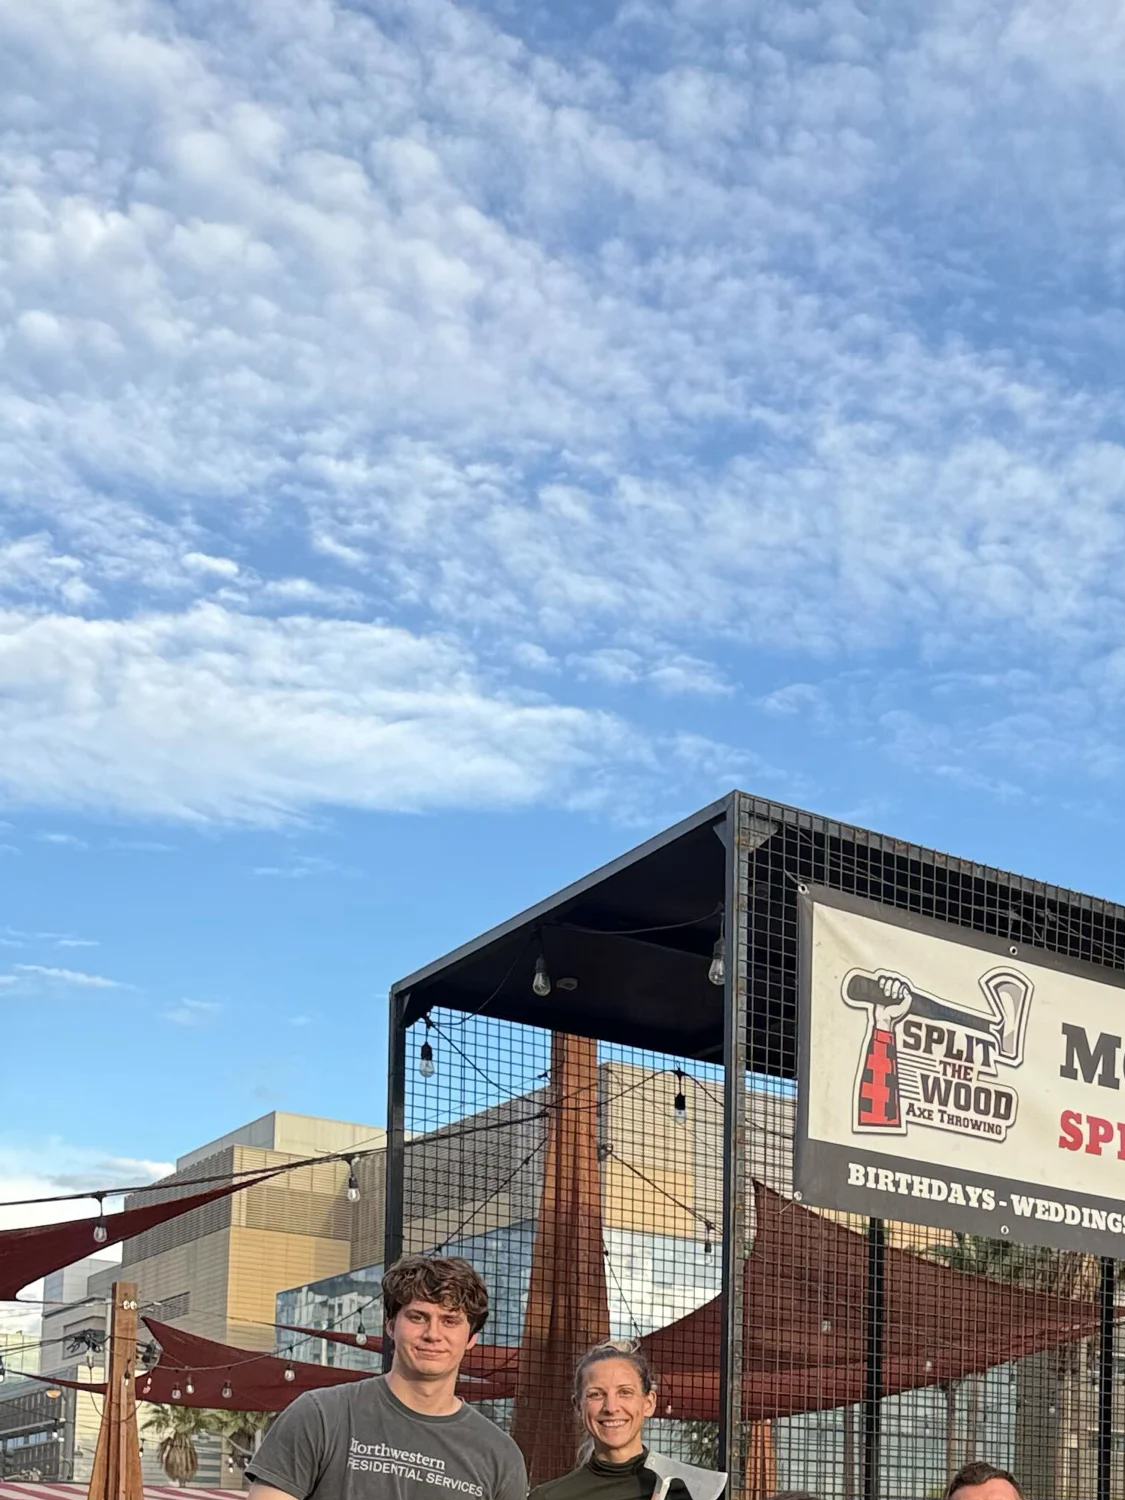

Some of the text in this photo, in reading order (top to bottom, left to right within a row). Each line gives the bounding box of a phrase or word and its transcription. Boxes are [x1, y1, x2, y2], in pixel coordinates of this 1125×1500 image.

[903, 1020, 996, 1068] SPLIT
[939, 1060, 973, 1081] THE
[920, 1073, 1013, 1120] WOOD
[848, 1163, 995, 1211] BIRTHDAYS
[350, 1437, 446, 1471] Northwestern
[347, 1456, 484, 1497] RESIDENTIAL SERVICES
